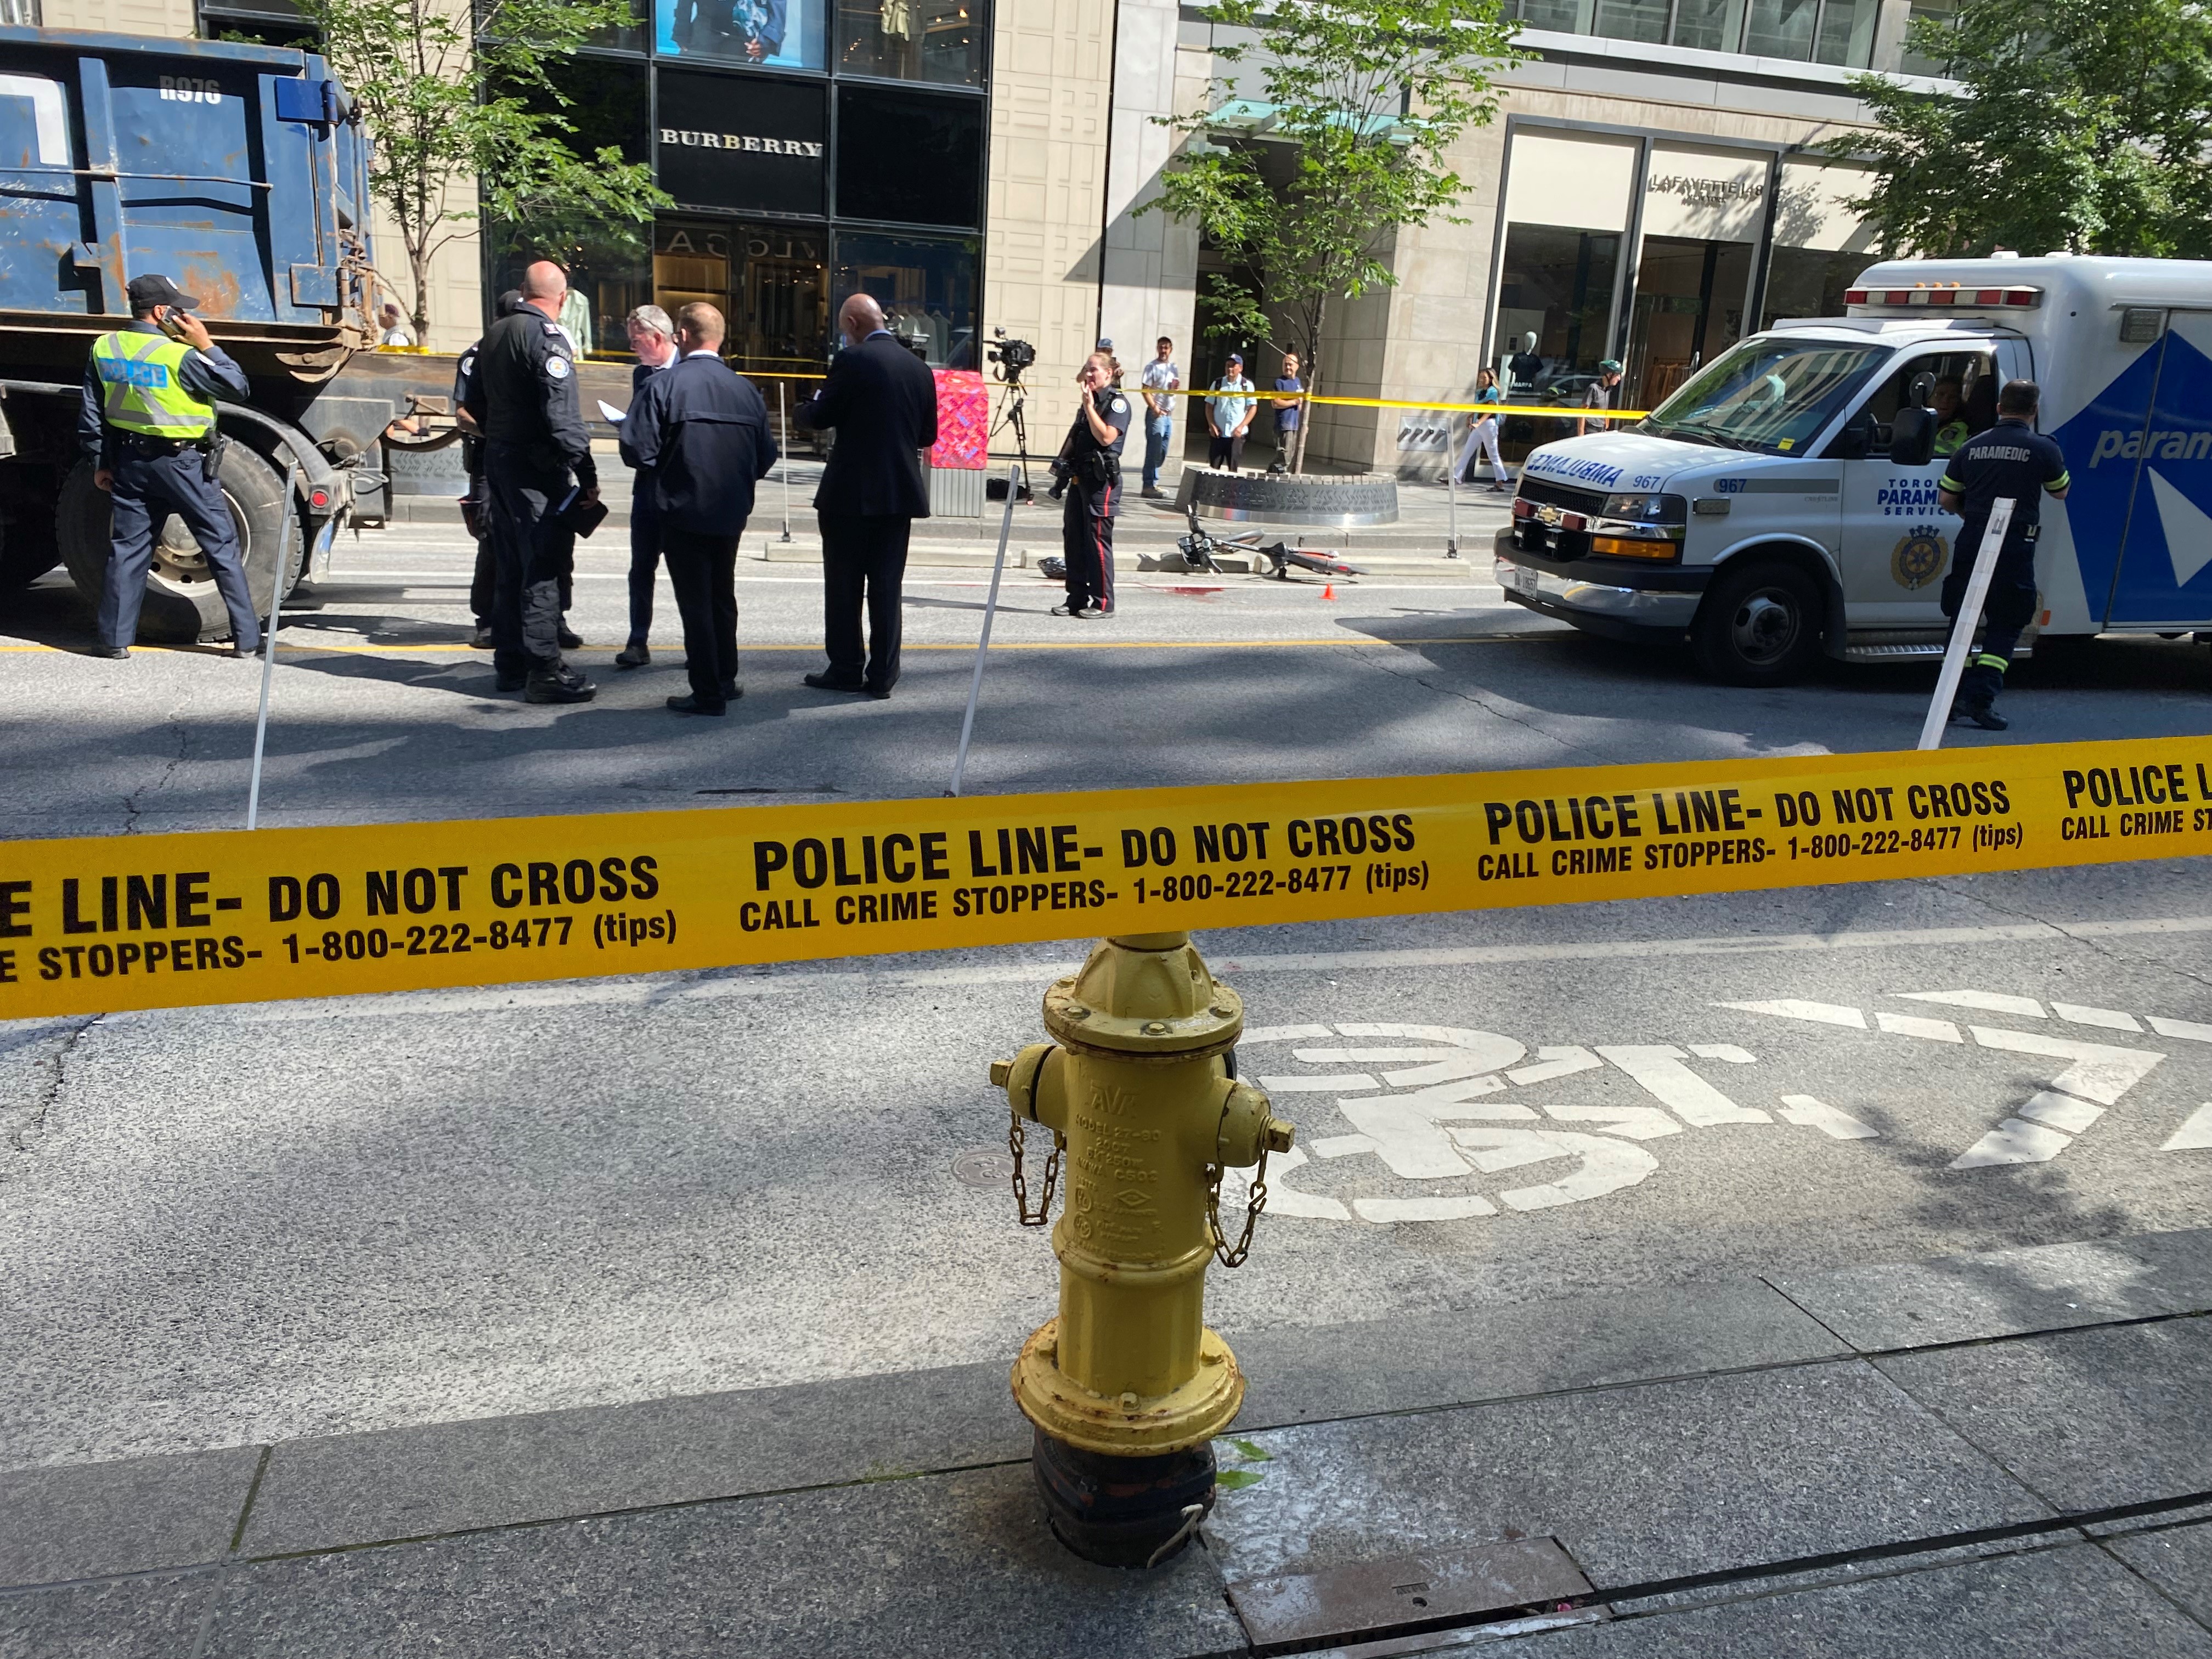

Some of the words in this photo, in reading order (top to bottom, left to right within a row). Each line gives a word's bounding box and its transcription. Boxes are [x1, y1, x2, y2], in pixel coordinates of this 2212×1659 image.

[159, 75, 221, 104] R976
[660, 129, 823, 157] BURBERRY
[1653, 174, 1737, 193] LAFAYETTE
[100, 361, 165, 386] POLICE
[1968, 446, 2030, 462] PARAMEDIC
[1632, 476, 1661, 489] 967
[1719, 478, 1747, 493] 967
[1889, 479, 1940, 488] TORO
[1877, 489, 1940, 505] PARAM
[1884, 506, 1954, 515] SERVIC
[2062, 763, 2190, 809] POLICE
[1483, 794, 1641, 845] POLICE
[1652, 789, 1763, 835] LINE-
[1775, 791, 1820, 828] DO
[1832, 787, 1894, 824] NOT
[1908, 781, 2011, 820] CROSS
[2062, 815, 2111, 841] CALL
[2120, 810, 2183, 837] CRIME
[754, 832, 950, 891] POLICE
[968, 825, 1103, 878] LINE-
[1121, 827, 1176, 868] DO
[1194, 822, 1269, 864] NOT
[1288, 814, 1415, 858] CROSS
[1477, 852, 1539, 881] CALL
[1551, 846, 1632, 876] CRIME
[1644, 837, 1776, 870] STOPPERS-
[1788, 826, 1961, 861] 1-800-222-8477
[1973, 822, 2023, 853] (tips)
[63, 872, 242, 934] LINE-
[268, 873, 340, 922] DO
[366, 866, 469, 916] NOT
[491, 855, 659, 909] CROSS
[740, 899, 820, 932] CALL
[836, 890, 937, 925] CRIME
[953, 879, 1118, 917] STOPPERS-
[1133, 865, 1351, 904] 1-800-222-8477
[1365, 860, 1429, 894] (tips)
[38, 935, 262, 980] STOPPERS-
[282, 916, 573, 963] 1-800-222-8477
[593, 910, 677, 949] (tips)
